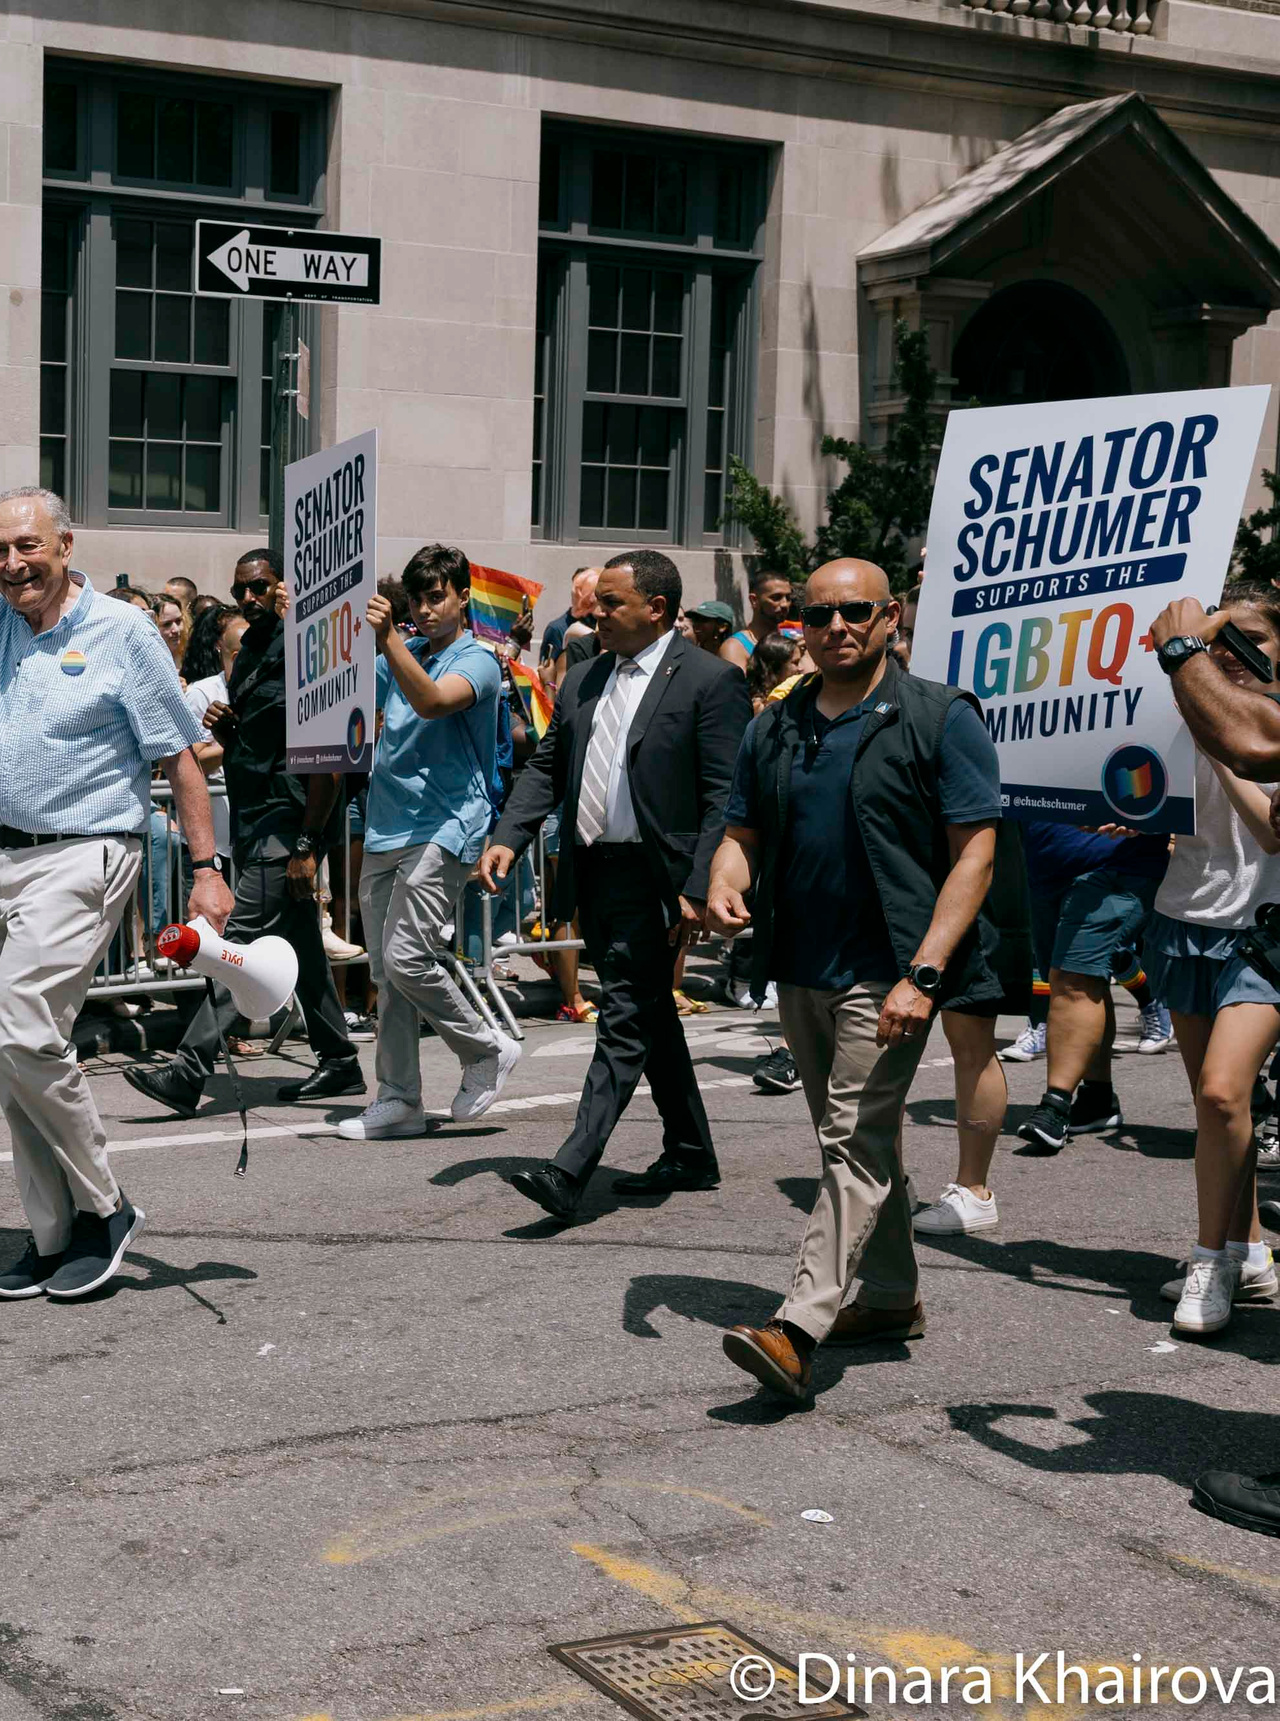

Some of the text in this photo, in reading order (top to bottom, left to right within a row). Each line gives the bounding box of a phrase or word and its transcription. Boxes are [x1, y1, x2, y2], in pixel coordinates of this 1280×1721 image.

[227, 246, 358, 282] ONE WAY
[963, 413, 1219, 520] SENATOR
[294, 453, 365, 549] SENATOR
[294, 508, 364, 597] SCHUMER
[953, 485, 1202, 583] SCHUMER
[302, 569, 353, 615] SUPPORTS THE
[974, 563, 1148, 609] SUPPORTS THE
[296, 600, 362, 690] LGBTQ+
[297, 662, 359, 726] COMMUNITY
[985, 686, 1144, 744] MMUNITY
[1012, 795, 1087, 811] @chuckschumer
